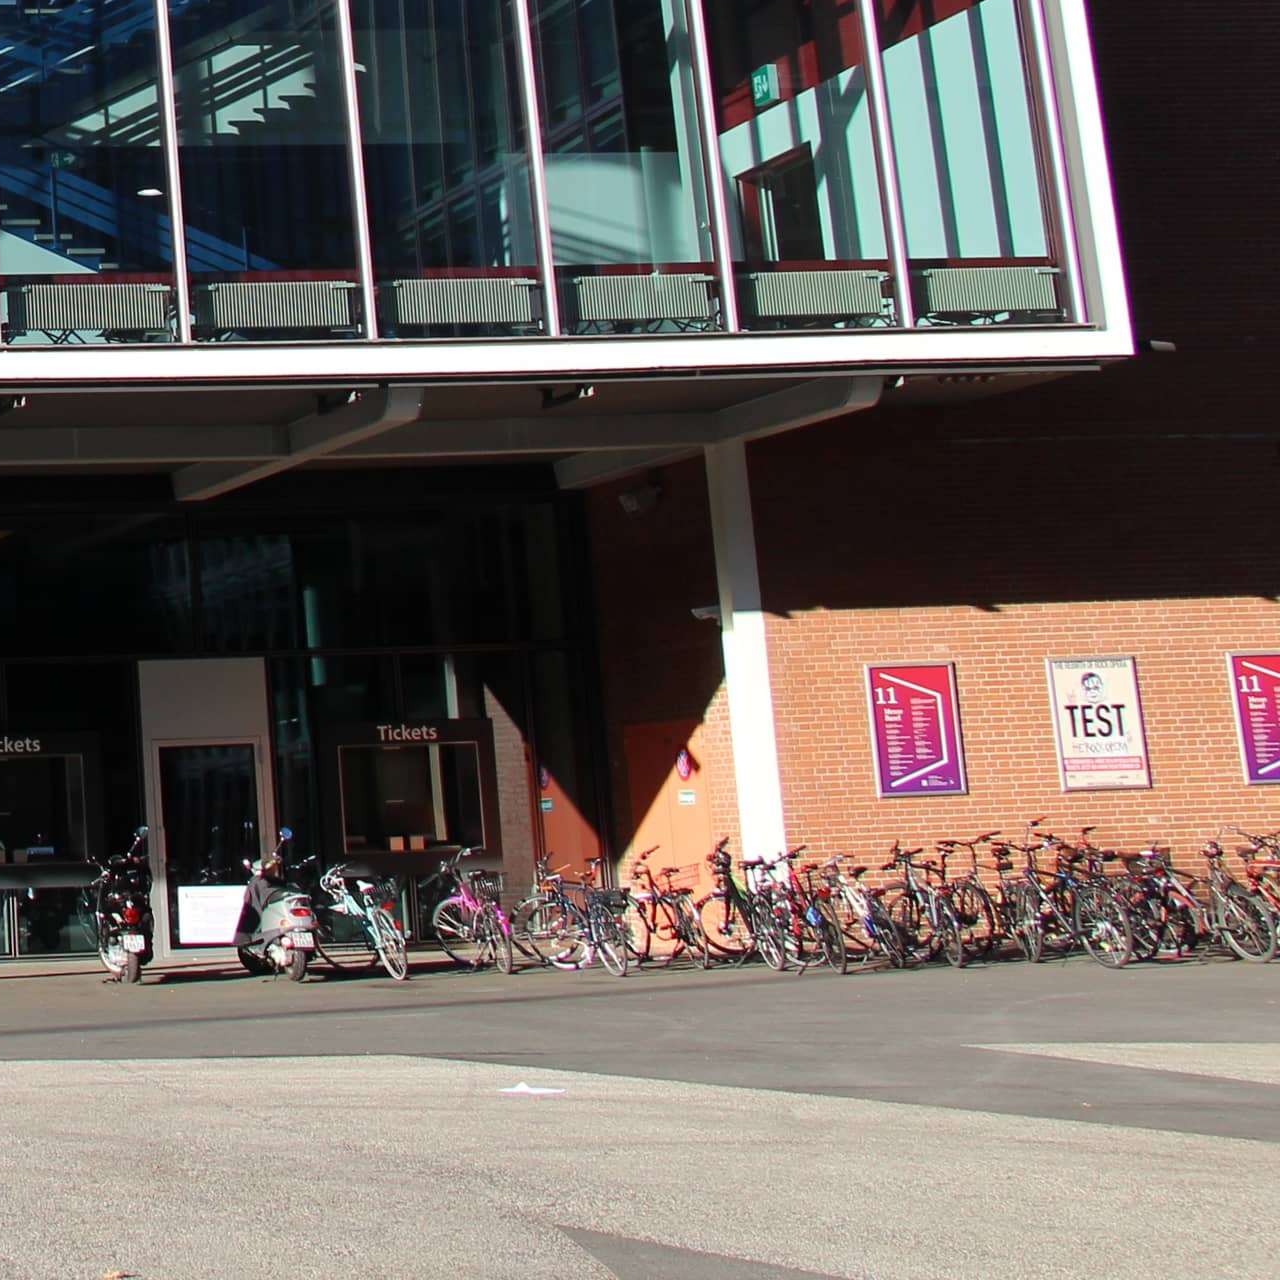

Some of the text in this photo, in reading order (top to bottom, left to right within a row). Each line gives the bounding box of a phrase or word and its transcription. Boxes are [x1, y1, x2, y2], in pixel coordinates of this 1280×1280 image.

[1237, 675, 1262, 693] 11
[874, 687, 898, 704] 11
[1064, 704, 1126, 738] TEST
[377, 724, 438, 740] Tickets
